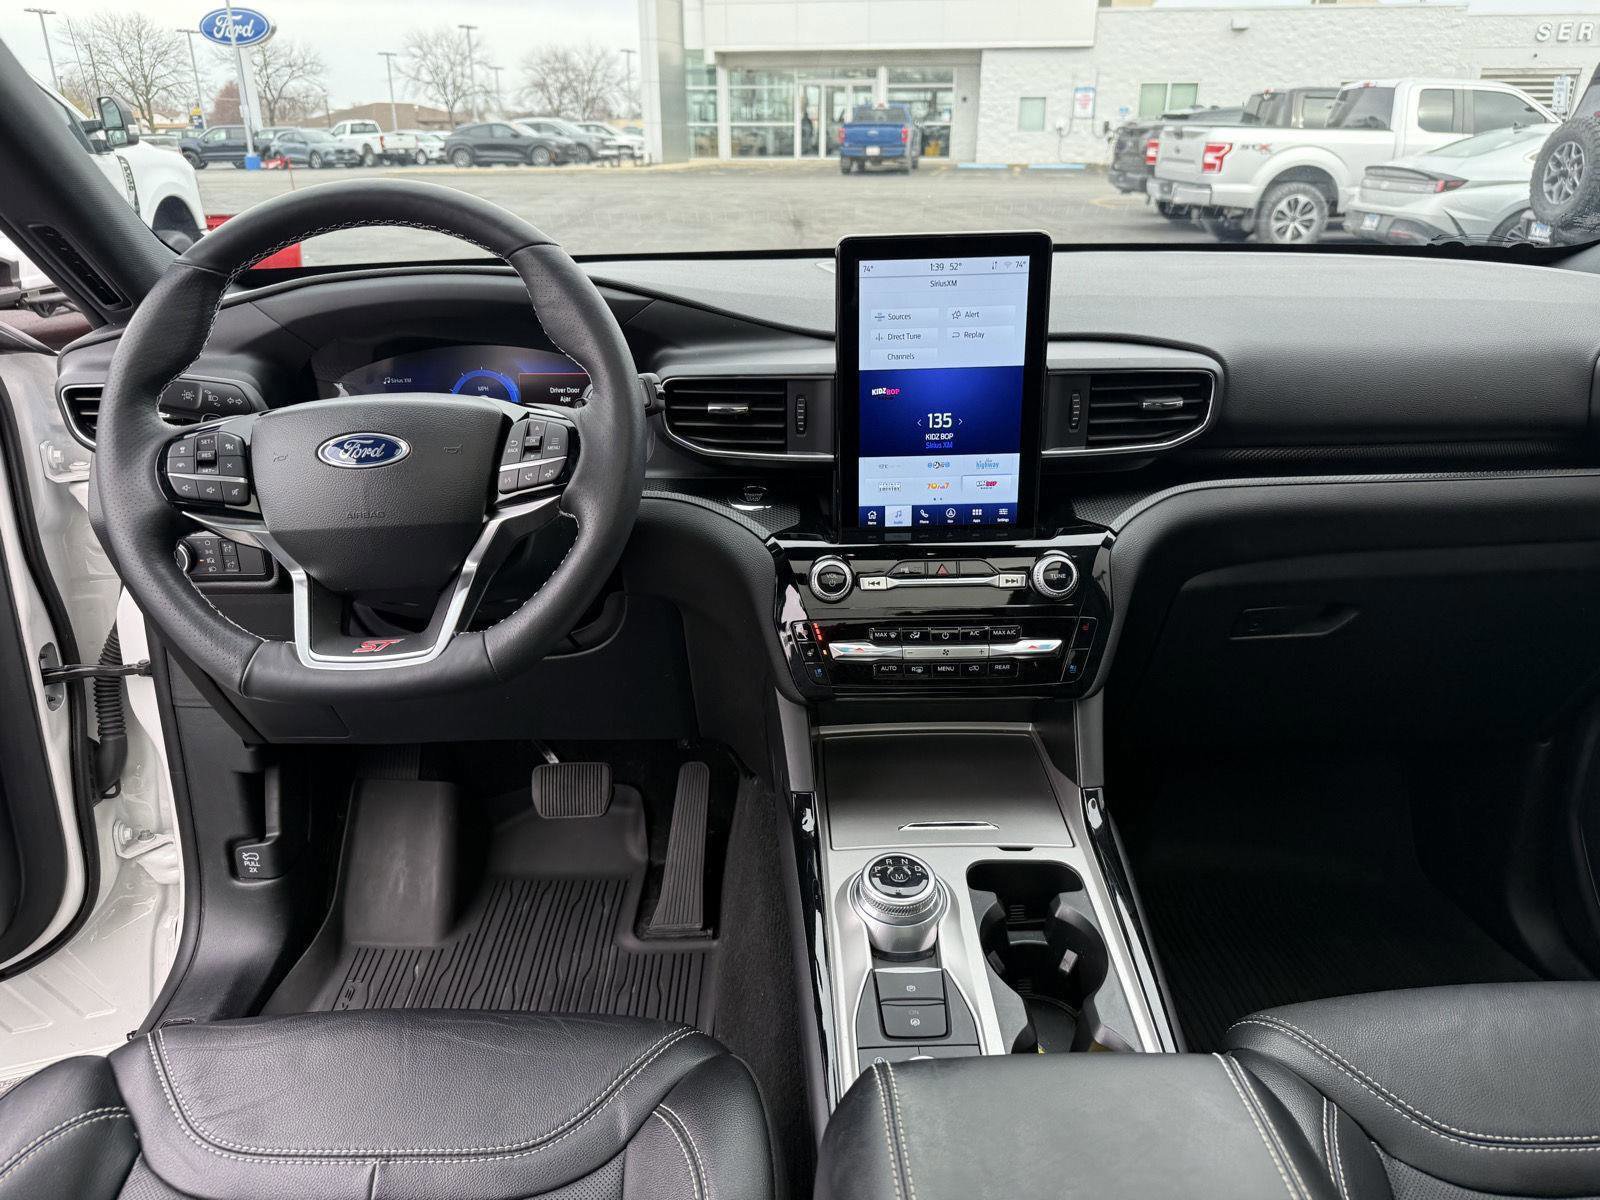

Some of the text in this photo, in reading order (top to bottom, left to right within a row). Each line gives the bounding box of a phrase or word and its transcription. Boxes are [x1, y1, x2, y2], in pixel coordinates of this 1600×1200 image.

[930, 262, 963, 271] 1:39 52°
[906, 332, 922, 340] Tune
[964, 331, 985, 340] Replay
[927, 413, 952, 428] 135
[925, 433, 940, 441] KIDZ
[338, 439, 385, 458] Ford
[352, 638, 405, 653] ST
